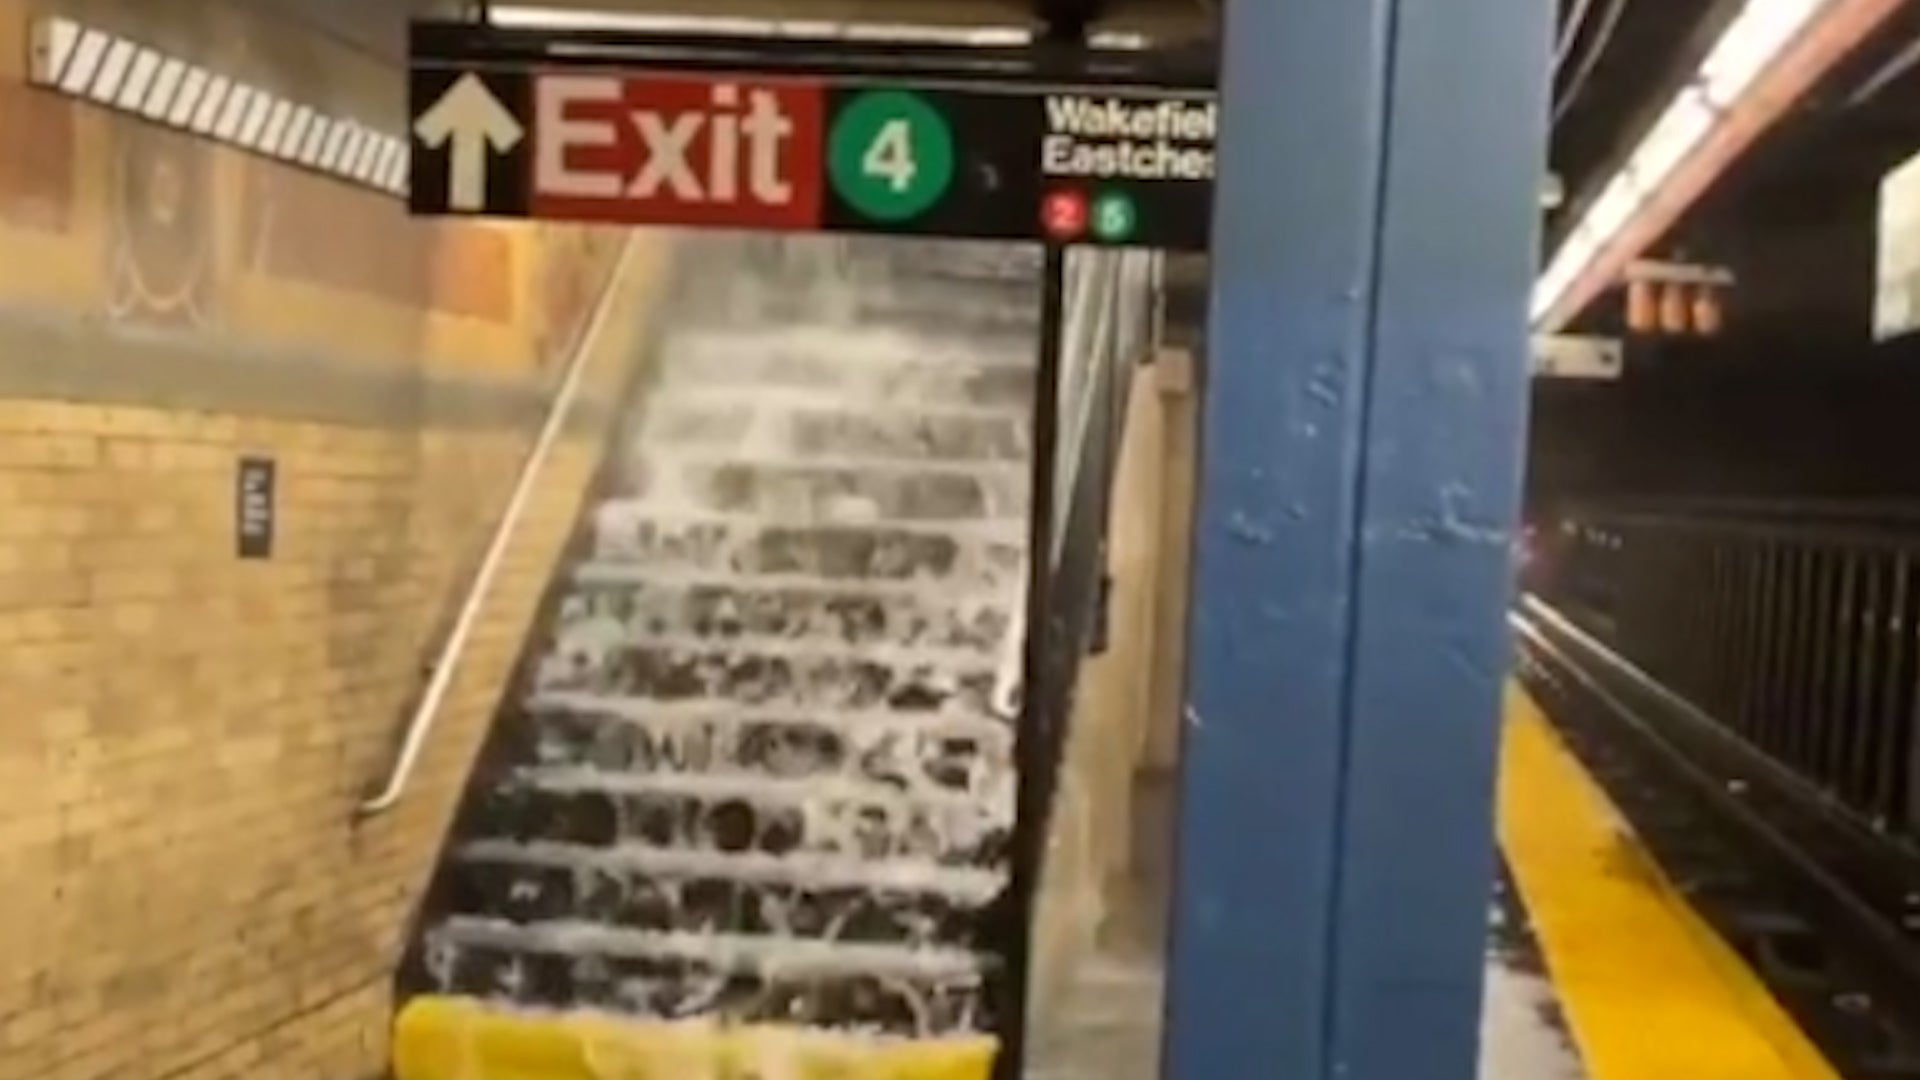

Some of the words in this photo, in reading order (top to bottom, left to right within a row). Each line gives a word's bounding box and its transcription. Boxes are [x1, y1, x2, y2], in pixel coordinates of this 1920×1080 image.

[535, 75, 794, 204] Exit
[1045, 95, 1216, 139] Wakefiel
[861, 117, 918, 193] 4
[1042, 134, 1216, 179] Eastche
[1051, 198, 1079, 232] 2
